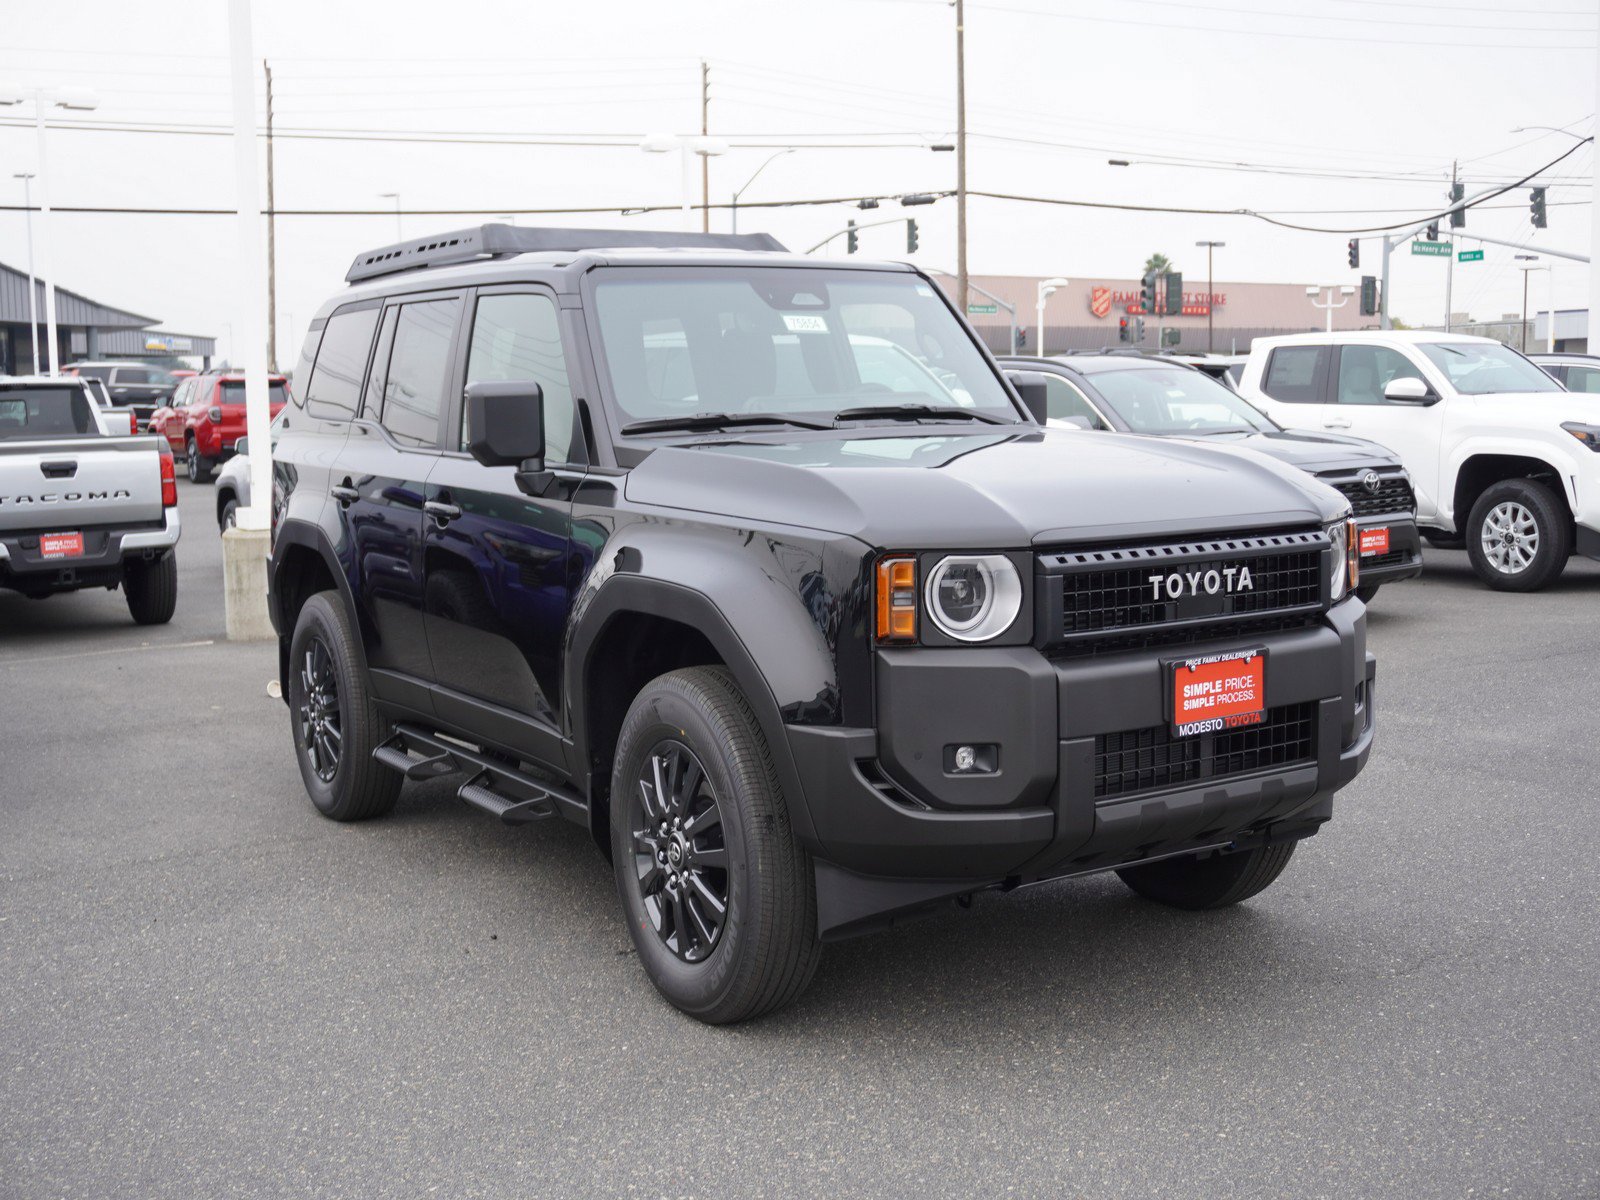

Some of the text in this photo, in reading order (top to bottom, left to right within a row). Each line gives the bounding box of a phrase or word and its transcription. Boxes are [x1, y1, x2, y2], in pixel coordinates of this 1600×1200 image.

[1148, 566, 1254, 600] TOYOTA
[1185, 651, 1256, 667] PRICE FAMILY DEALERSHIPS
[1183, 675, 1255, 697] SIMPLE PRICE.
[1183, 690, 1255, 711] SIMPLE PROCESS.
[1179, 713, 1261, 737] MODESTO TOYOTA
